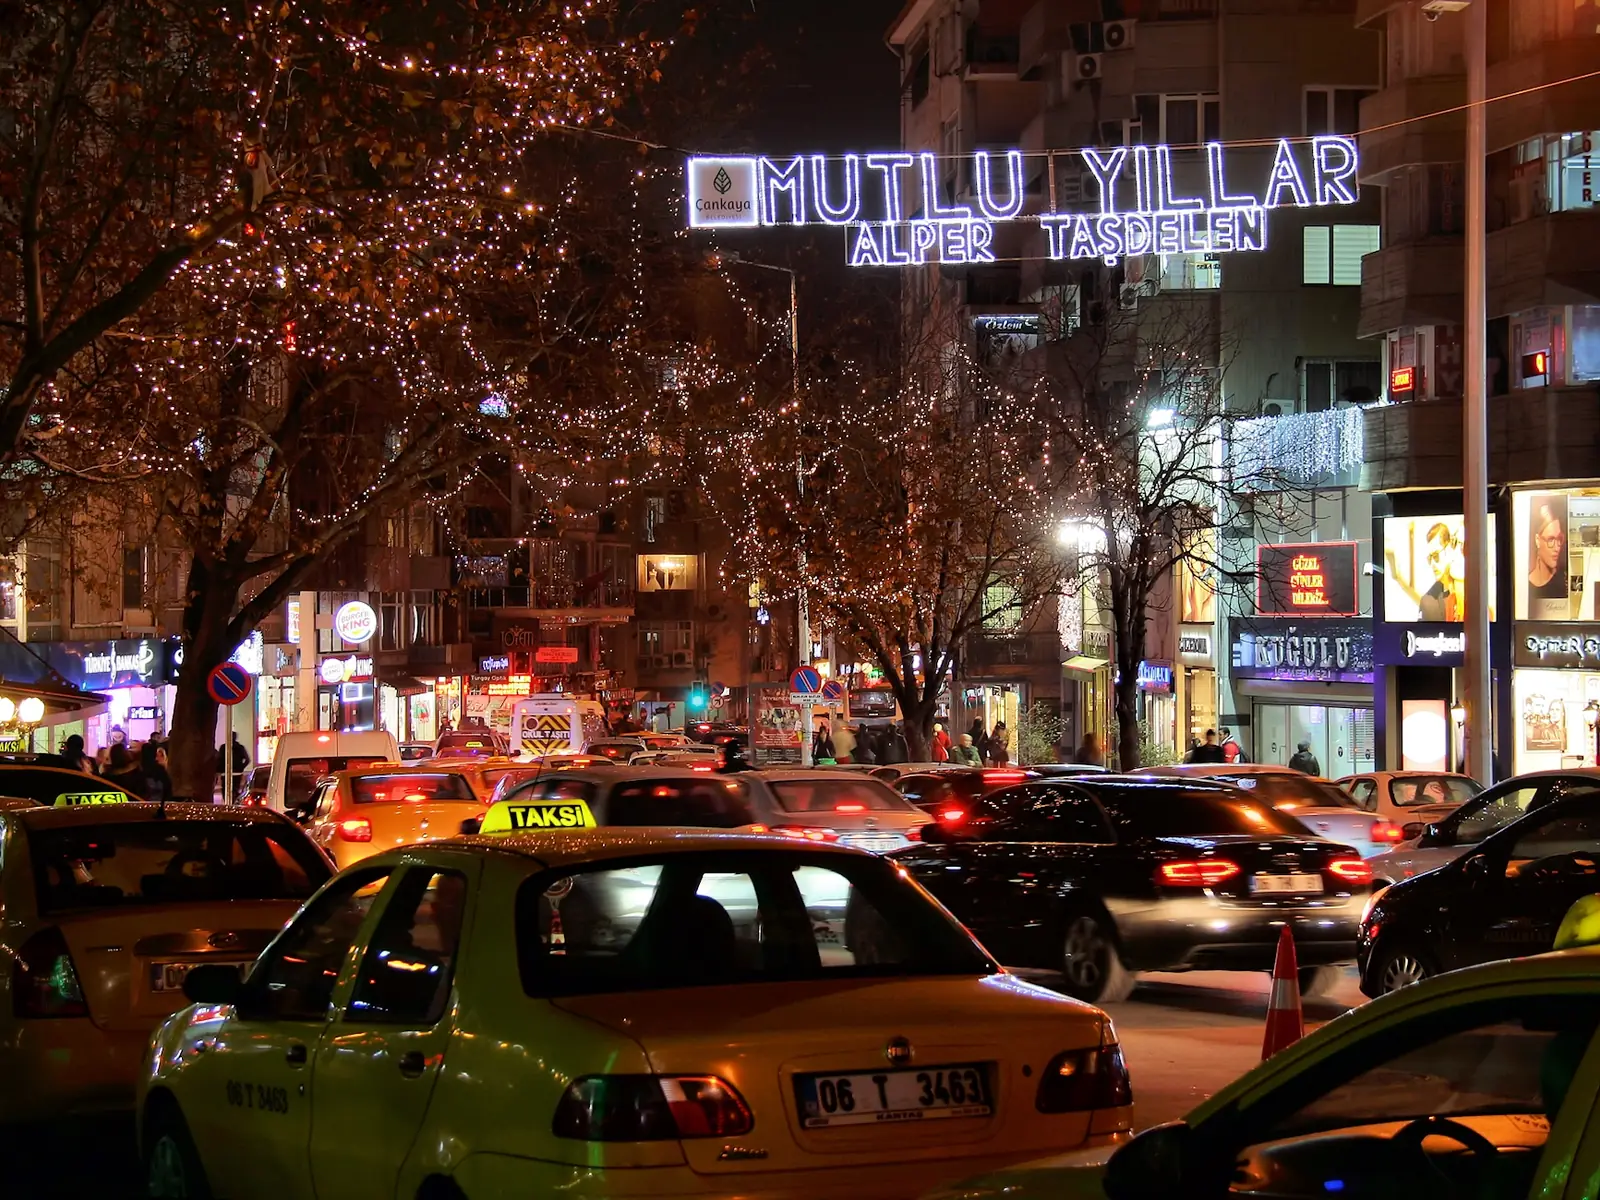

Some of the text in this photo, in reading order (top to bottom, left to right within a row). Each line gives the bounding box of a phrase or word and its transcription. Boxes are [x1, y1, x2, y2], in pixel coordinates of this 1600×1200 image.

[759, 135, 1358, 226] MUTLU YILLAR
[695, 198, 751, 212] Çankaya
[851, 207, 1267, 267] ALPER TAŞDELEN
[1292, 555, 1320, 571] GÜZEL
[341, 610, 369, 624] BURGER
[342, 618, 370, 632] KING
[1255, 626, 1350, 669] KUĞULU
[84, 653, 111, 674] TÜRKİYE
[357, 658, 373, 676] KING
[522, 731, 544, 739] OKUL
[226, 1079, 289, 1115] 06 T 3463
[819, 1070, 983, 1114] 06 T 3463
